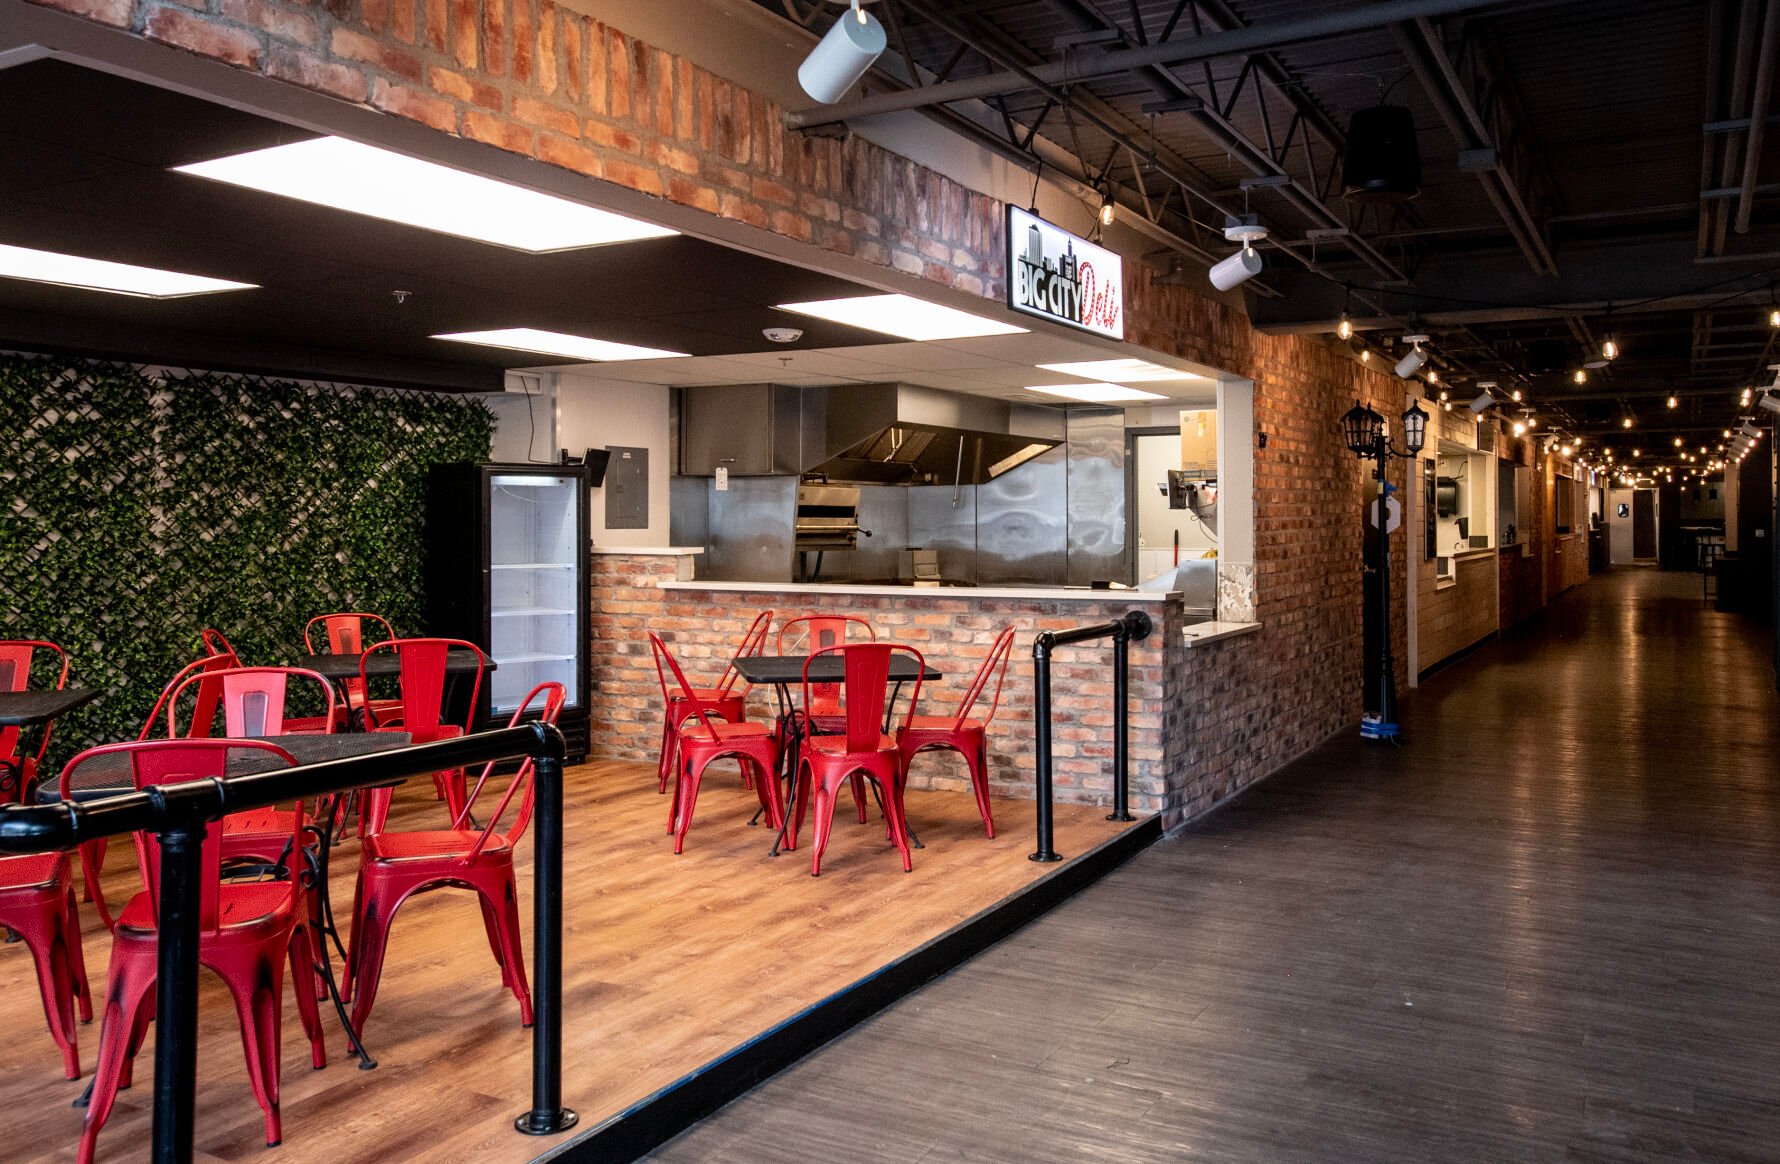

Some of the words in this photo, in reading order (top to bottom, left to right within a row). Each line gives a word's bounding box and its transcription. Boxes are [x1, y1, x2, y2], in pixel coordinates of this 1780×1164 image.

[1018, 261, 1047, 310] BIG
[1048, 273, 1082, 322] CITY
[1078, 261, 1119, 330] Deli
